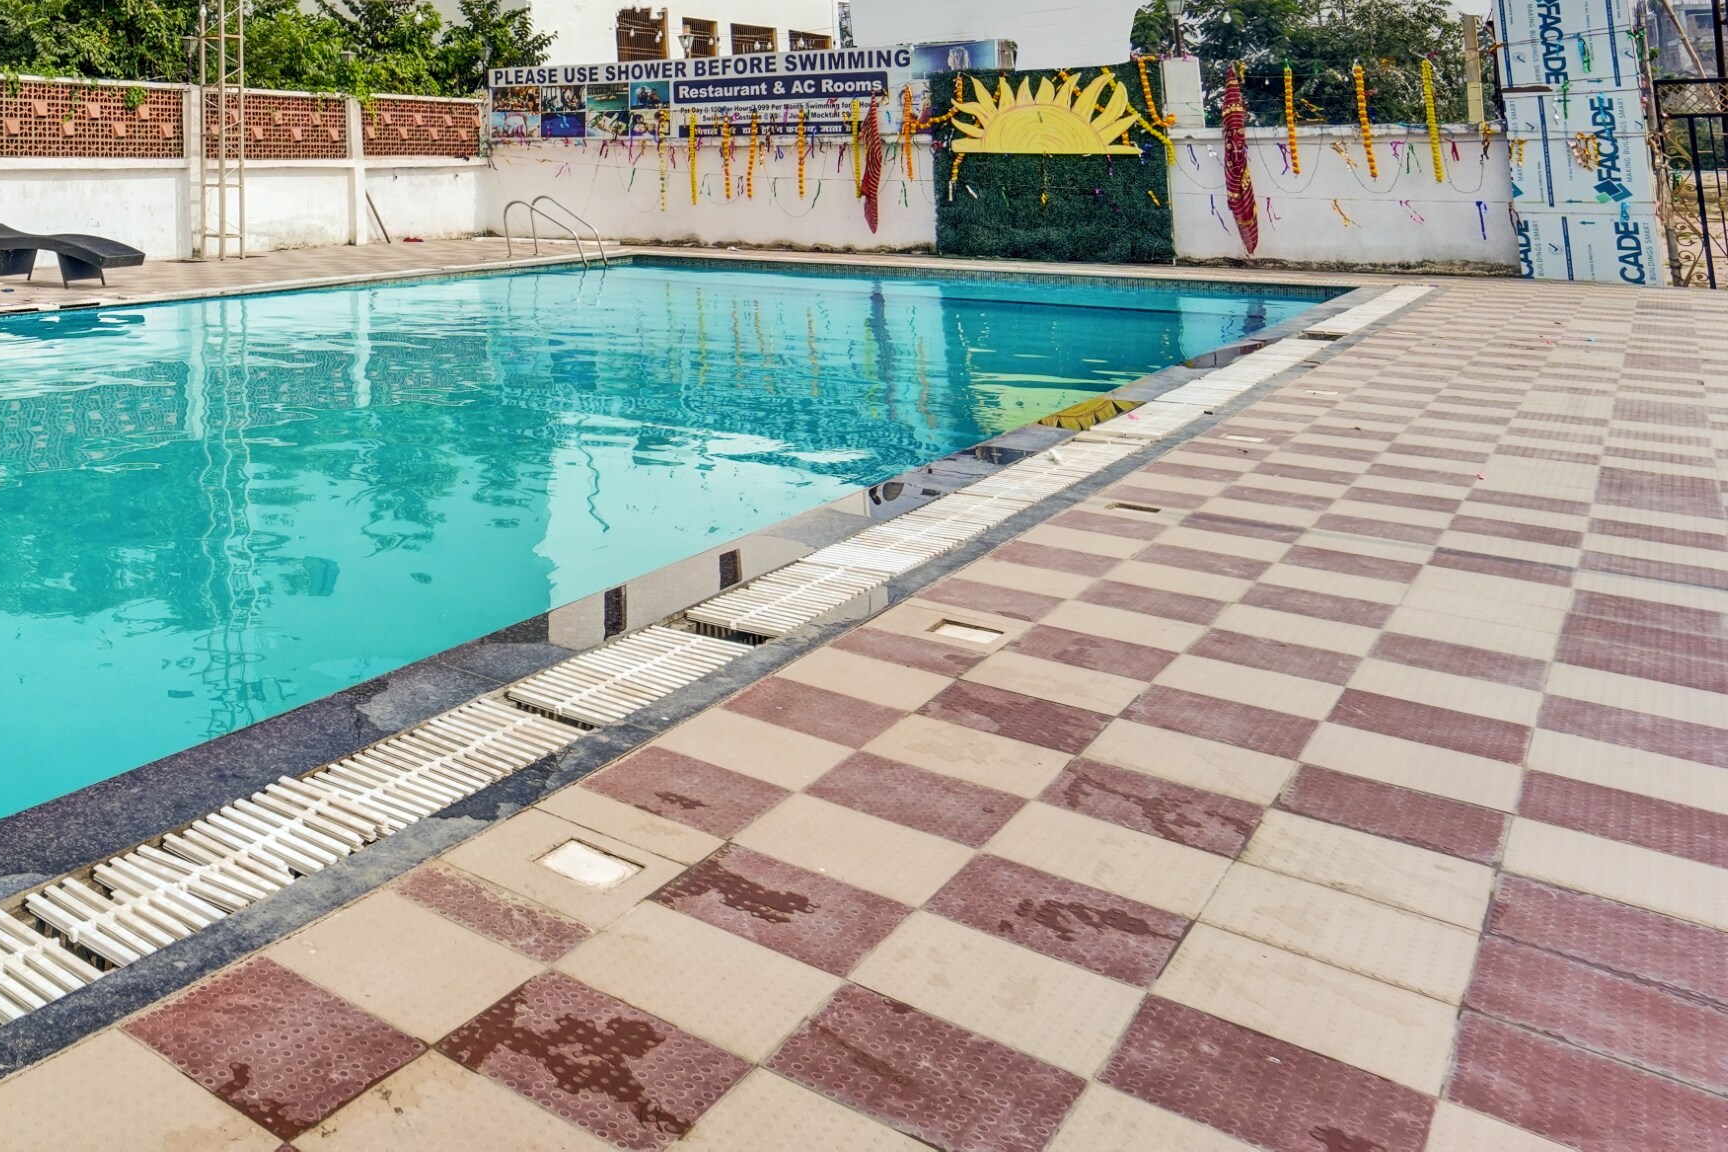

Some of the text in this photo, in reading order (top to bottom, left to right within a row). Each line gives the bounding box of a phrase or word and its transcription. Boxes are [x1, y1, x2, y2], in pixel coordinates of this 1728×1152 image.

[1527, 3, 1536, 28] MAKING
[1537, 2, 1569, 84] FACADE
[494, 49, 911, 85] PLEASE USE SHOWER BEFORE SWIMMING
[678, 77, 883, 99] Restaurant & AC Rooms
[1509, 100, 1518, 120] SMART
[1617, 97, 1626, 119] SMART
[1589, 97, 1622, 182] FACADE
[1623, 156, 1633, 183] MAKING
[1532, 220, 1545, 276] BUILDINGS SMART
[1642, 222, 1657, 281] BUILDINGS SMART
